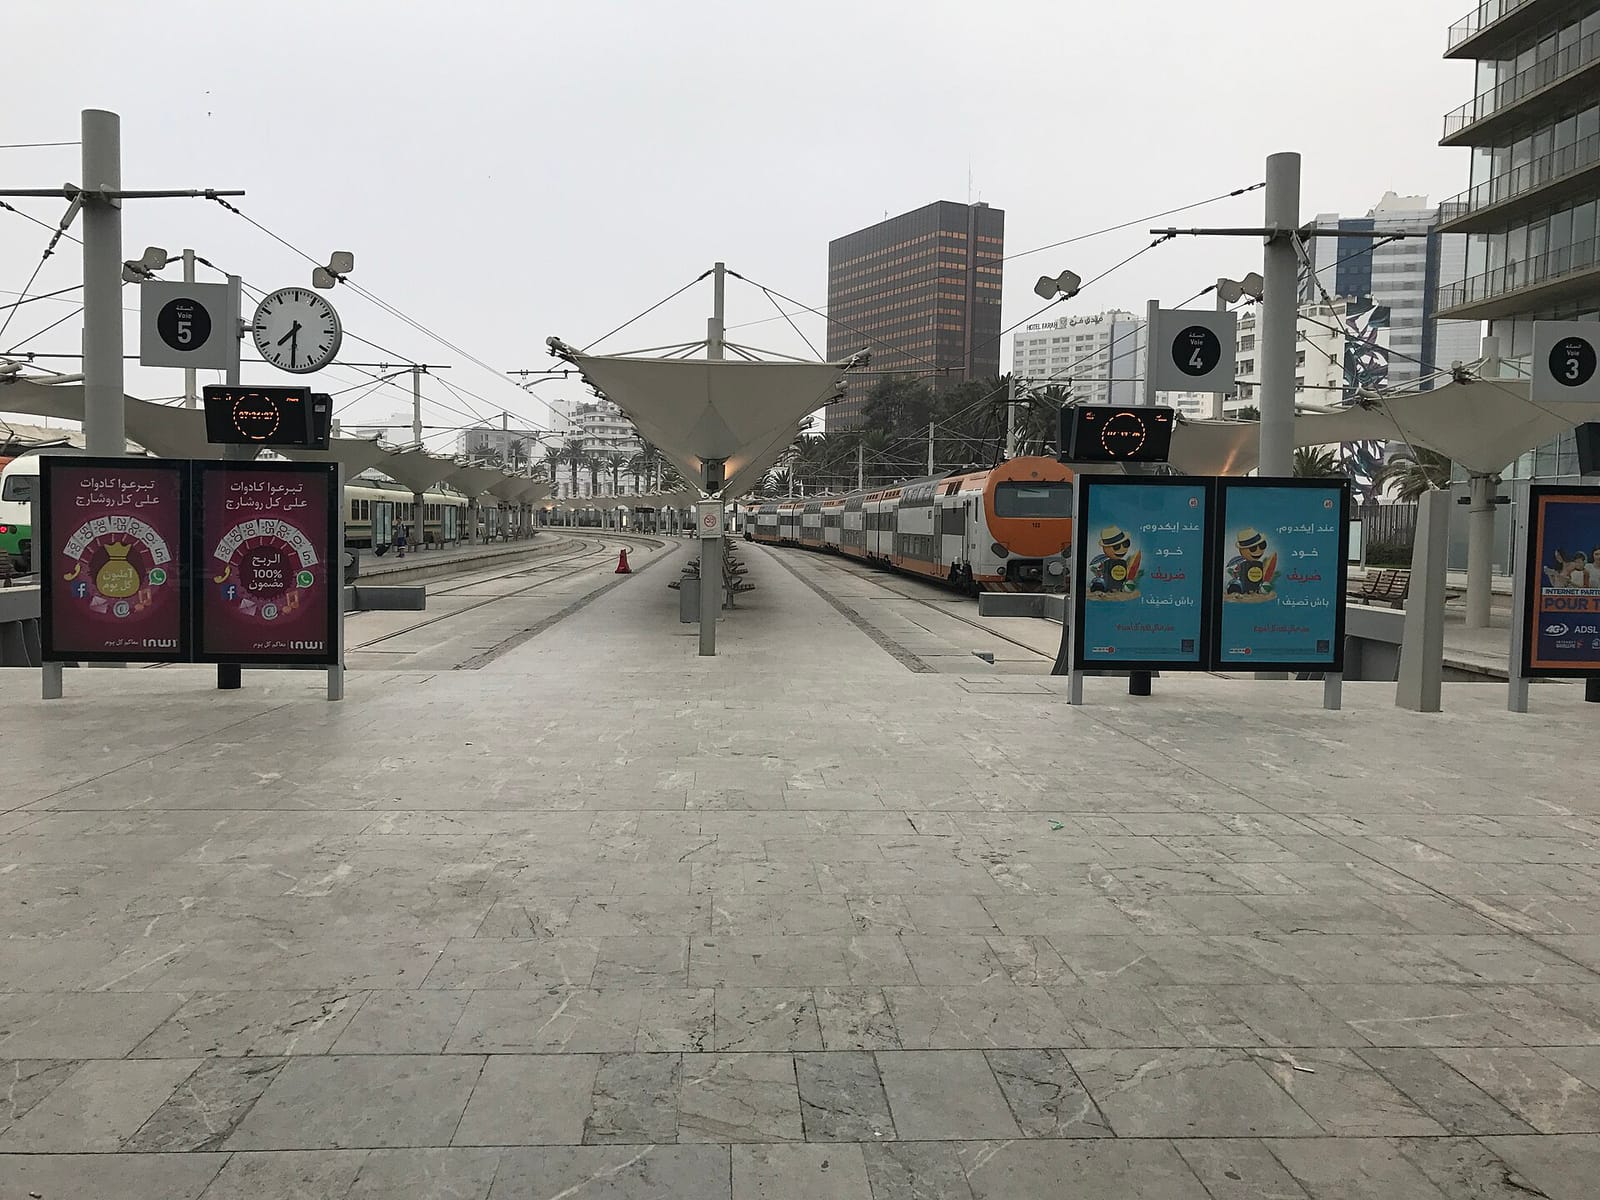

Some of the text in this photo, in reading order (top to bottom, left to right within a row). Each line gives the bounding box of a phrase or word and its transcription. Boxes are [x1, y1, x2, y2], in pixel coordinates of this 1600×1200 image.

[178, 321, 192, 344] 5
[1189, 348, 1203, 369] 4
[1565, 358, 1579, 379] 3
[80, 478, 156, 492] تبرعوا كادوات
[230, 481, 304, 495] تبرعوا كادوات
[75, 493, 160, 508] على كل روشارج
[225, 496, 308, 511] على كل روشارج
[96, 519, 107, 534] 30
[116, 518, 127, 532] 25
[128, 521, 141, 536] 20
[245, 522, 256, 537] 30
[265, 520, 275, 535] 25
[276, 524, 288, 539] 20
[1182, 522, 1200, 531] عند
[1317, 524, 1335, 532] عند
[79, 526, 94, 540] 50
[141, 532, 155, 545] 10
[229, 529, 243, 543] 50
[67, 541, 81, 553] 100
[288, 535, 302, 548] 10
[154, 548, 164, 558] 5
[217, 544, 231, 555] 100
[302, 551, 311, 561] 5
[1155, 546, 1184, 558] خود
[1291, 548, 1319, 559] خود
[252, 554, 280, 568] الربح
[253, 569, 283, 579] 100%
[102, 580, 133, 593] كل يوم
[248, 579, 284, 591] مضمون
[1174, 596, 1194, 607] باش
[1310, 598, 1329, 608] باش
[1544, 597, 1588, 610] POUR
[1574, 625, 1598, 634] ADSL
